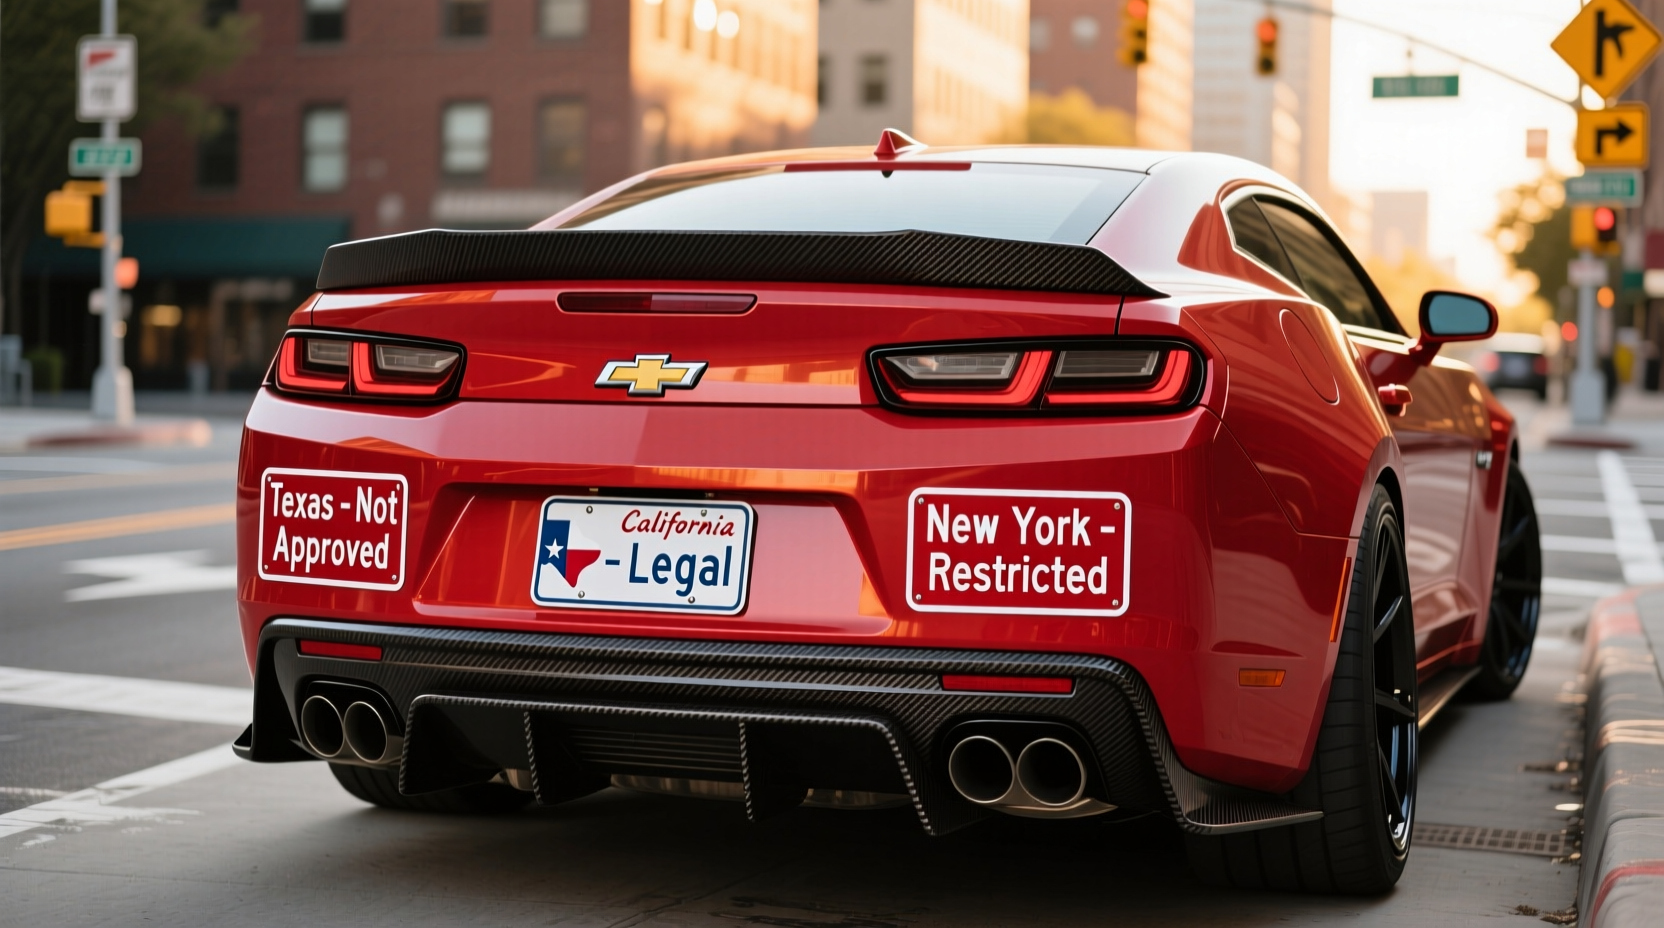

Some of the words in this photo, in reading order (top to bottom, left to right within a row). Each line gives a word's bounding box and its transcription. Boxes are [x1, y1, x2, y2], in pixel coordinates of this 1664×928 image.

[270, 482, 334, 521] Texas
[355, 486, 398, 525] Not
[621, 509, 735, 540] California
[927, 503, 999, 544] New
[1011, 505, 1091, 546] York
[272, 525, 390, 573] Approved
[929, 552, 1108, 594] Restricted
